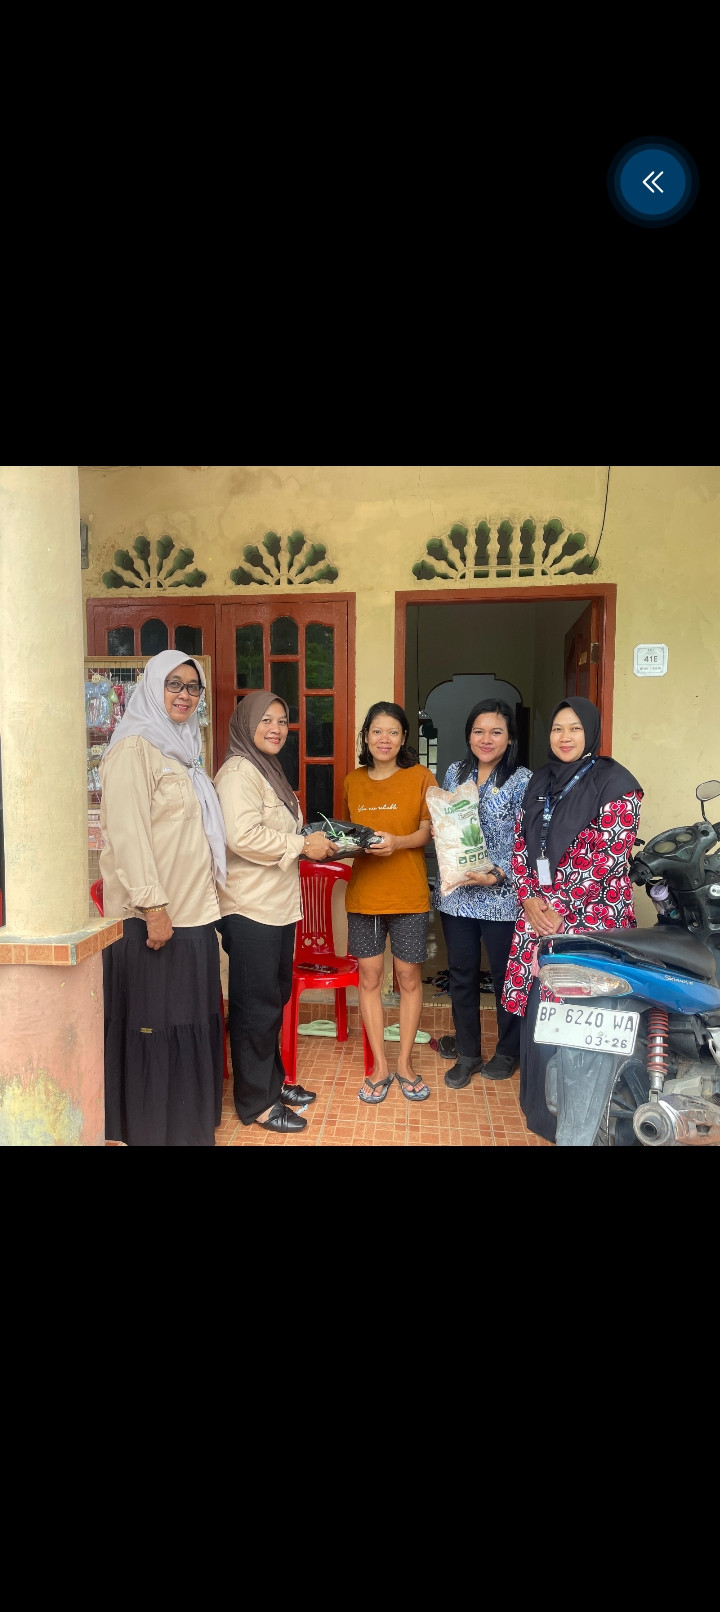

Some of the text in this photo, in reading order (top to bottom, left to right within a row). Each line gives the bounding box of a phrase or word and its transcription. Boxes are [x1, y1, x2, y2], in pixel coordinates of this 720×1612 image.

[539, 1006, 634, 1033] BP 6240 WA
